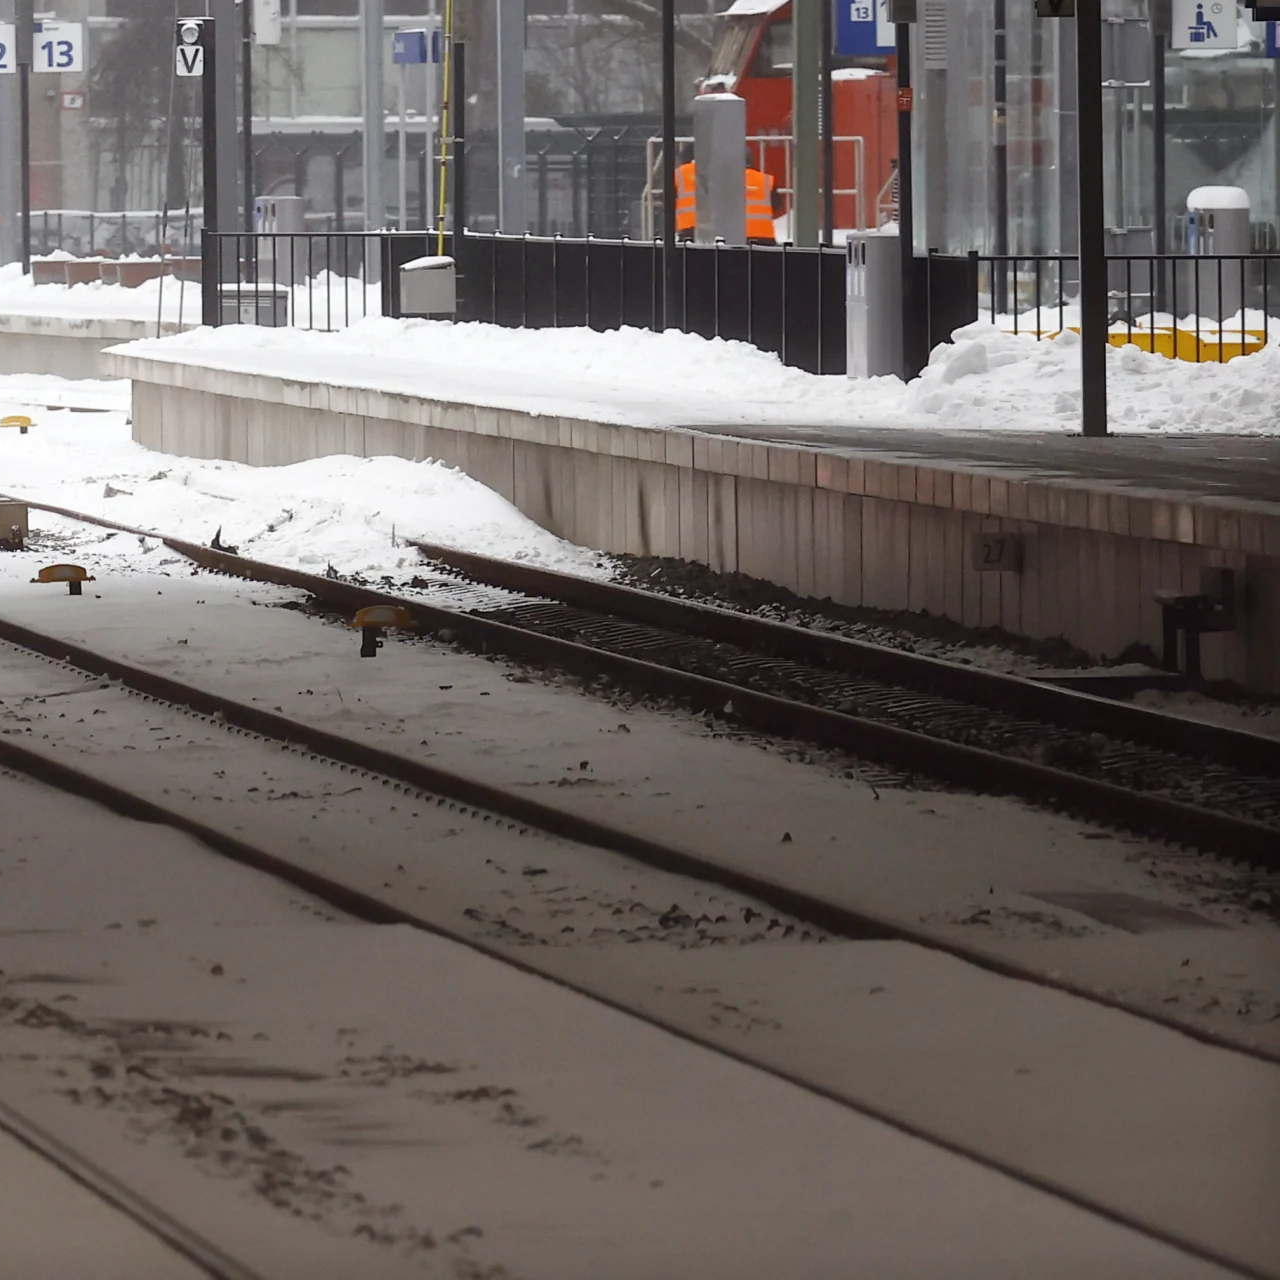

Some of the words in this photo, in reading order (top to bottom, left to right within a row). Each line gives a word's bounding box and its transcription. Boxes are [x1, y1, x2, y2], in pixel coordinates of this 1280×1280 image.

[854, 6, 870, 19] 13
[41, 40, 74, 68] 13
[180, 48, 200, 74] V
[983, 539, 1006, 564] 27
